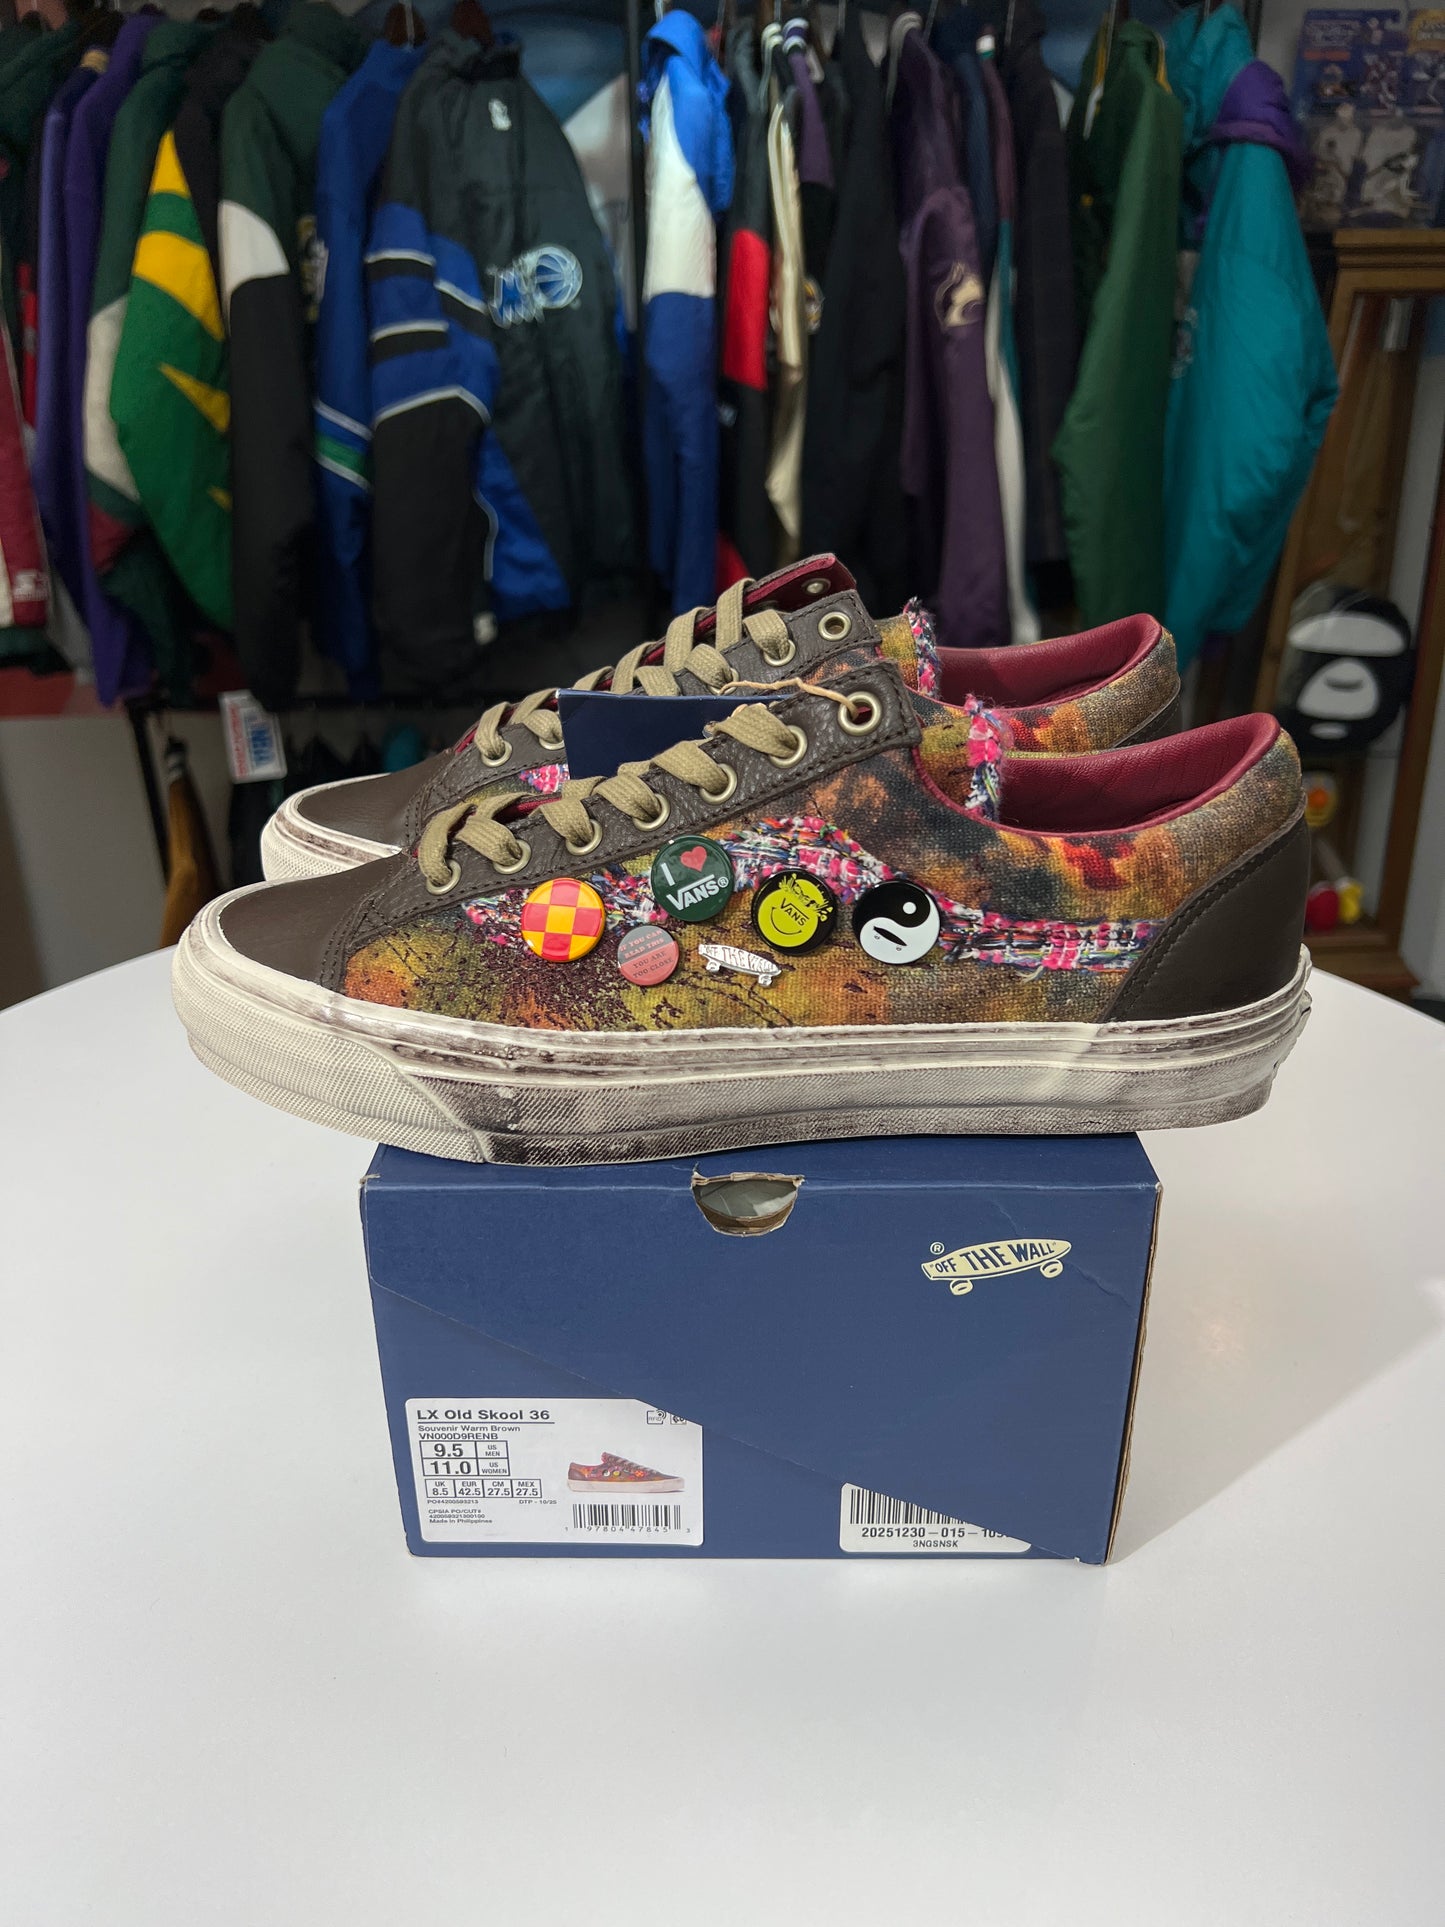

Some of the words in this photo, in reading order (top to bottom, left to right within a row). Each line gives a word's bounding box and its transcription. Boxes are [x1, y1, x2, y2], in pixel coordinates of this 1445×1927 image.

[660, 862, 675, 887] I
[780, 897, 810, 926] VANS
[633, 959, 649, 969] YOU
[633, 968, 649, 978] TOO
[960, 1246, 1012, 1271] THE
[417, 1409, 440, 1420] LX
[444, 1409, 472, 1420] Old
[478, 1409, 524, 1420] Skool
[529, 1410, 551, 1420] 36
[419, 1432, 499, 1440] VN000D9RENB
[433, 1443, 464, 1457] 9.5
[430, 1460, 471, 1475] 11.0
[432, 1488, 449, 1496] 8.5
[458, 1488, 481, 1496] 42.5
[487, 1488, 511, 1496] 27.5
[515, 1488, 539, 1496] 27.5
